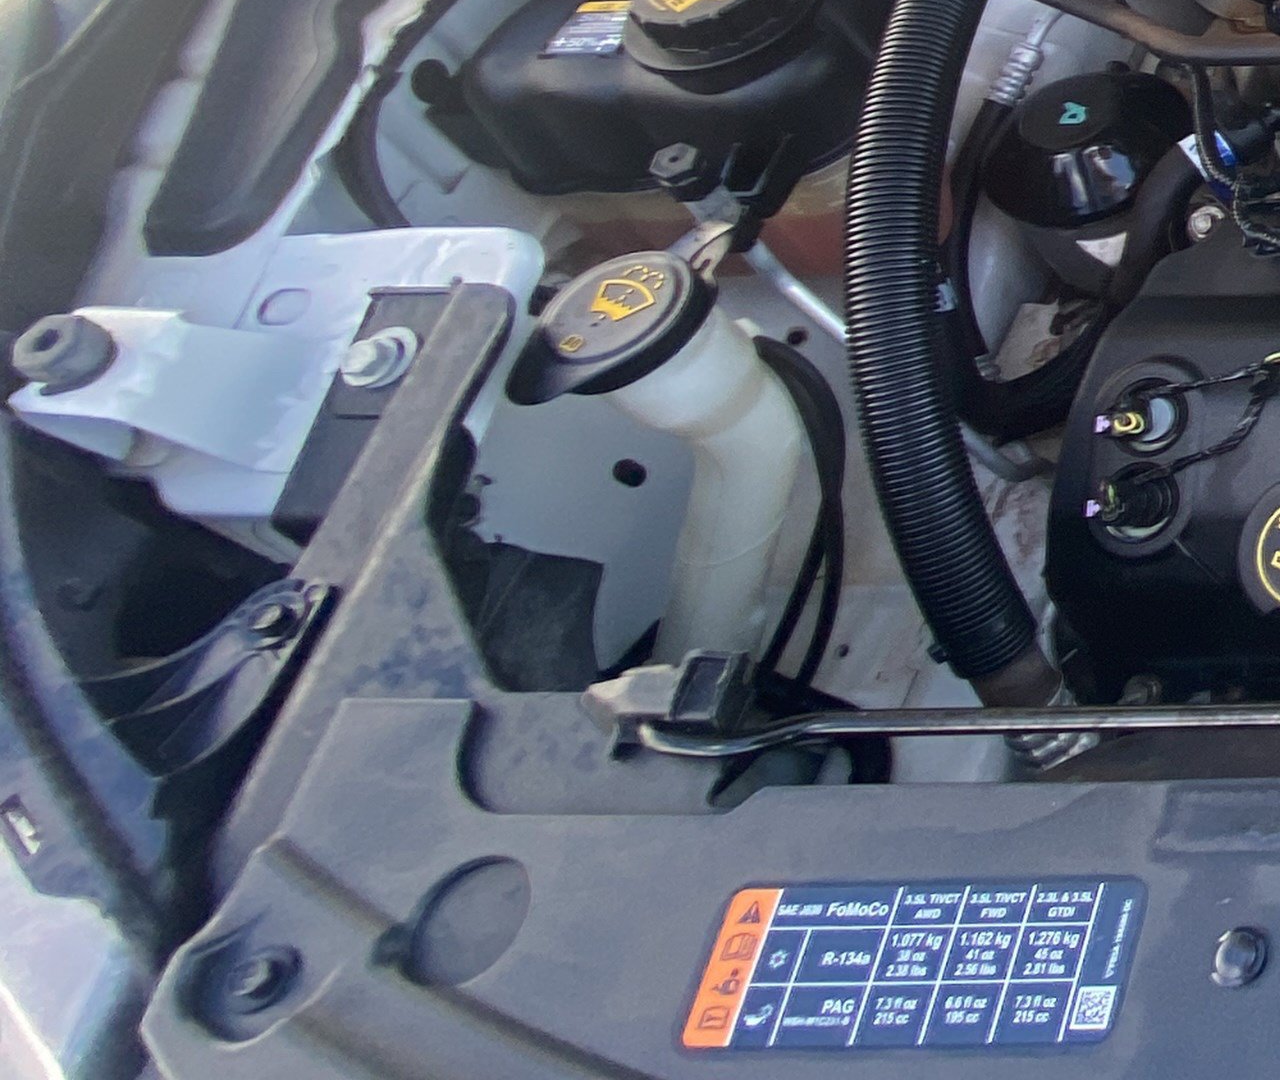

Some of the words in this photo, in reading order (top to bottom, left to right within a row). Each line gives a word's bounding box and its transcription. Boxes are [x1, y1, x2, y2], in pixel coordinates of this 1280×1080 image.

[826, 901, 889, 917] FoMoCo
[914, 908, 942, 919] AWD
[980, 907, 1007, 918] FWD
[925, 933, 944, 950] kg
[960, 931, 994, 946] 1.162
[994, 931, 1012, 949] kg
[1029, 930, 1061, 946] 1.276
[1062, 930, 1080, 948] kg
[821, 951, 871, 965] R-134a
[965, 949, 980, 960] 41
[981, 951, 995, 961] oz
[1049, 949, 1064, 960] oz
[821, 999, 855, 1014] PAG
[873, 1012, 895, 1025] 215
[1013, 1010, 1034, 1023] 215
